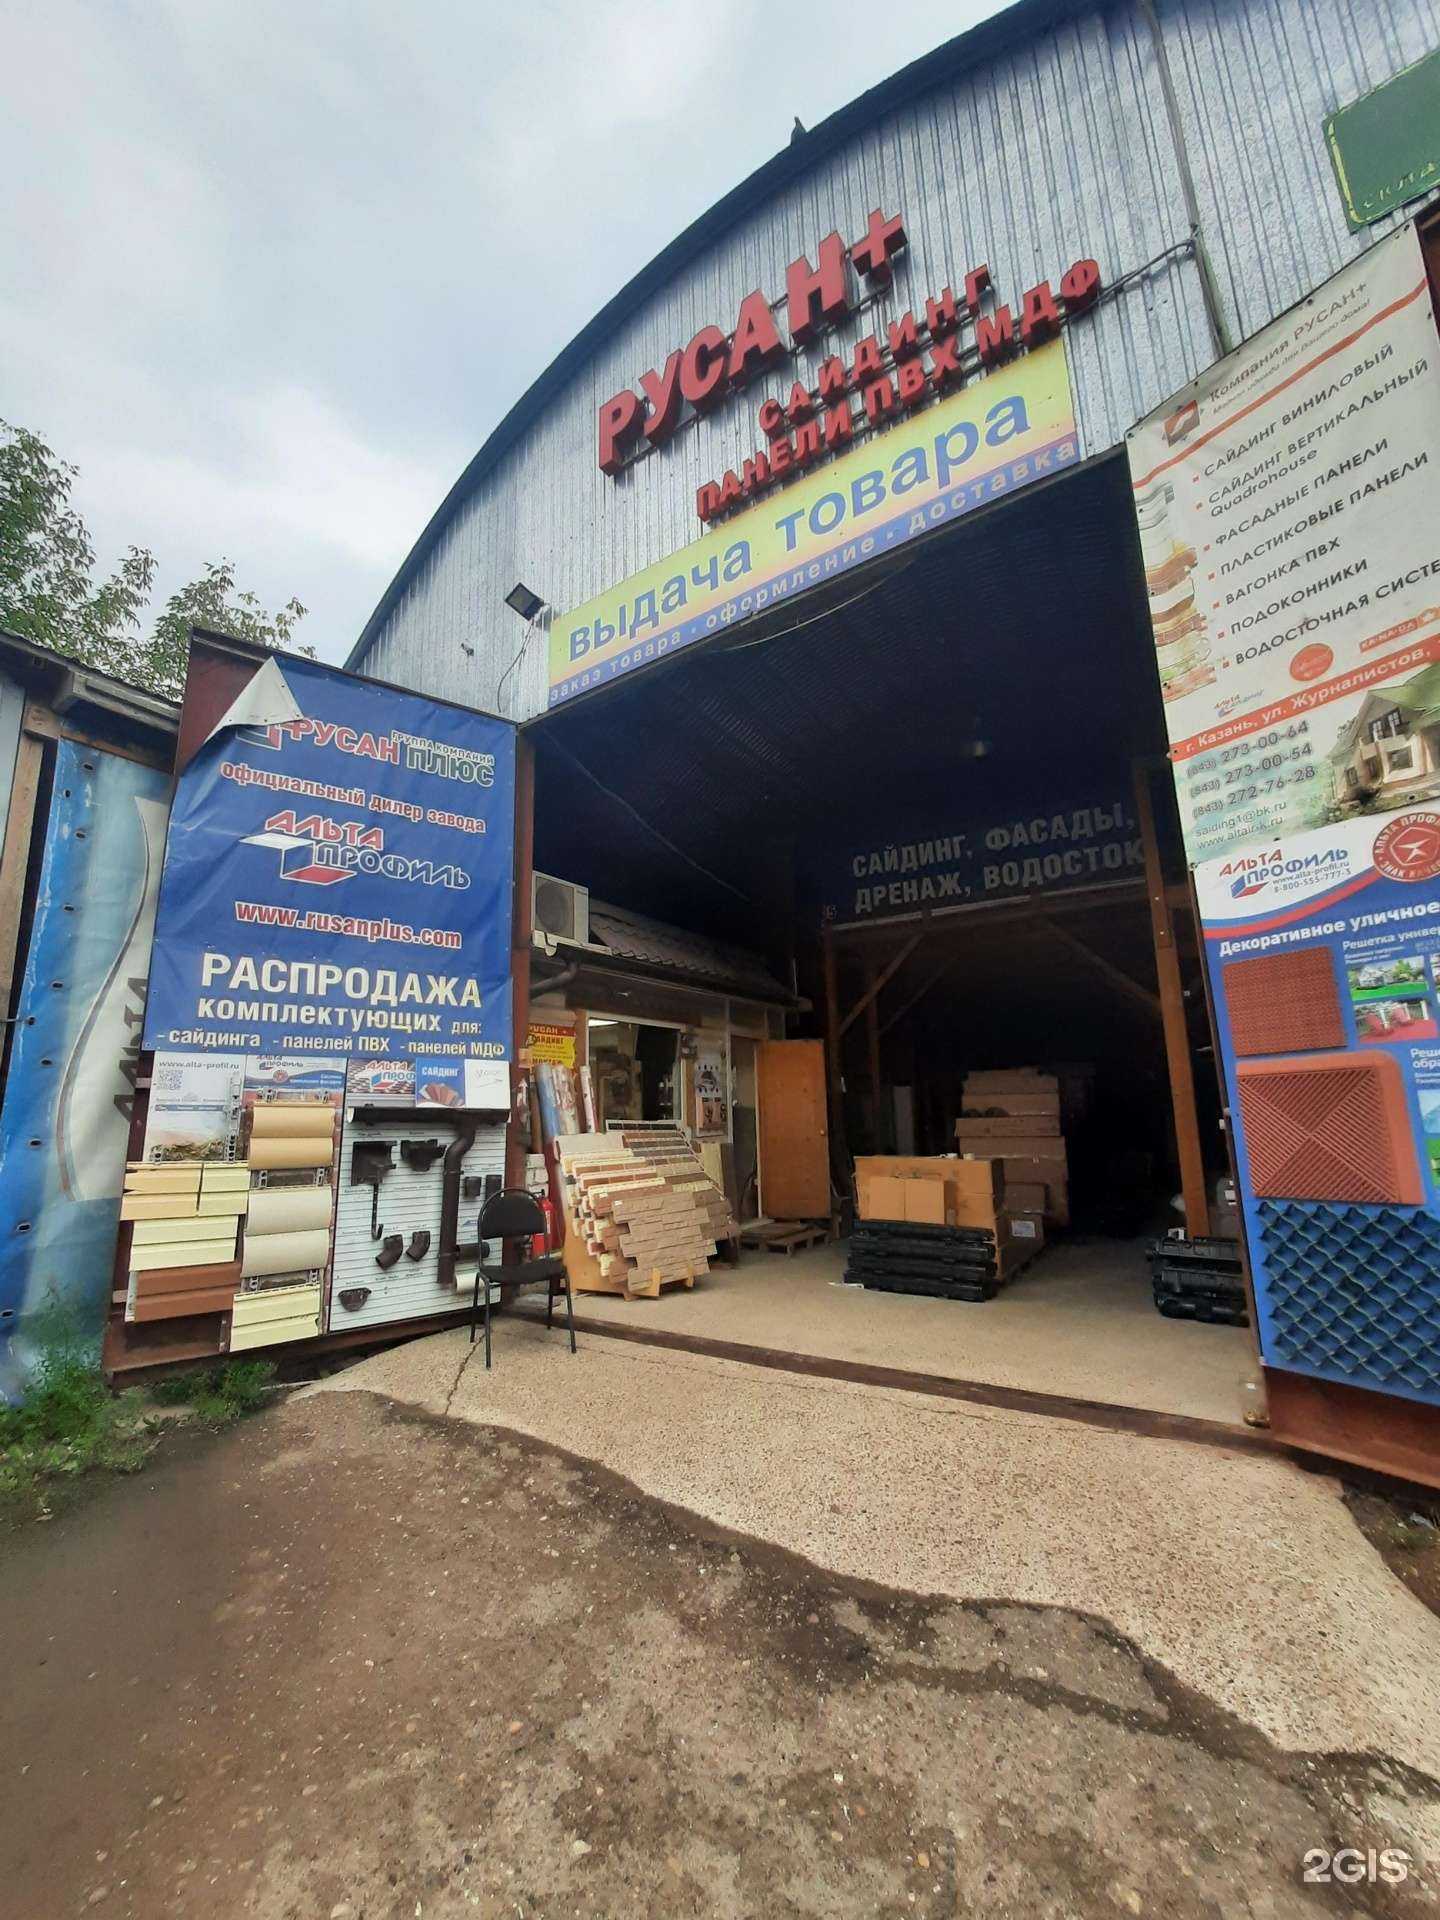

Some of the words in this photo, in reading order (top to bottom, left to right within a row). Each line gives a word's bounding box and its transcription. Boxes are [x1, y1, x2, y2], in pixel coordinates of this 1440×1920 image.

[759, 264, 991, 438] САЙДИНГ
[1208, 340, 1290, 402] Компания
[697, 402, 853, 522] ПАНЕЛИ
[866, 336, 962, 425] ПВХ
[977, 258, 1099, 364] МДФ
[1203, 421, 1278, 477] САЙДИНГ
[1281, 343, 1395, 427] ВИНИЛОВЫЙ
[1208, 450, 1283, 506] САЙДИНГ
[1287, 359, 1429, 455] ВЕРТИКАЛЬНЫЙ
[775, 395, 1031, 552] товара
[1210, 448, 1318, 518] Quadrohouse
[1215, 483, 1310, 546] ФАСАДНЫЕ
[1313, 438, 1389, 490] ПАНЕЛИ
[1220, 499, 1345, 577] ПЛАСТИКОВЫЕ
[1349, 452, 1429, 505] ПАНЕЛИ
[551, 668, 601, 702] заказ
[609, 630, 682, 673] товара
[706, 537, 875, 630] оформление
[908, 438, 1075, 537] доставка
[1225, 558, 1301, 606] ВАГОНКА
[1305, 536, 1341, 564] ПВХ
[1230, 559, 1368, 636] ПОДОКОННИКИ
[1235, 594, 1370, 666] ВОДОСТОЧНАЯ
[1198, 720, 1258, 747] Казань,
[1262, 706, 1286, 723] ул.
[1291, 647, 1431, 709] Журналистов,
[280, 717, 400, 765] РУСАН
[407, 745, 495, 787] ПЛЮС
[392, 730, 434, 751] ГРУППА
[434, 742, 495, 766] КОМПАНИЙ
[1221, 719, 1309, 763] 273-00-64
[1224, 742, 1313, 784] 273-00-54
[220, 761, 366, 808] официальный
[368, 794, 424, 822] дилер
[427, 807, 487, 834] завода
[1227, 766, 1316, 805] 272-76-28
[315, 842, 472, 890] ПРОФИЛЬ
[851, 834, 973, 879] САЙДИНГ,
[984, 802, 1136, 852] ФАСАДЫ,
[1246, 848, 1349, 884] ПРОФИЛЬ
[234, 900, 462, 950] www.rusanplus.com
[854, 871, 973, 915] ДРЕНАЖ,
[1219, 919, 1346, 959] Декоративное
[1350, 901, 1440, 932] уличное
[201, 953, 482, 1009] РАСПРОДАЖА
[198, 997, 442, 1033] комплектующих
[451, 1018, 482, 1036] для:
[358, 1036, 391, 1053] ПВХ
[470, 1041, 505, 1058] МДФ
[421, 1066, 461, 1078] САЙДИНГ
